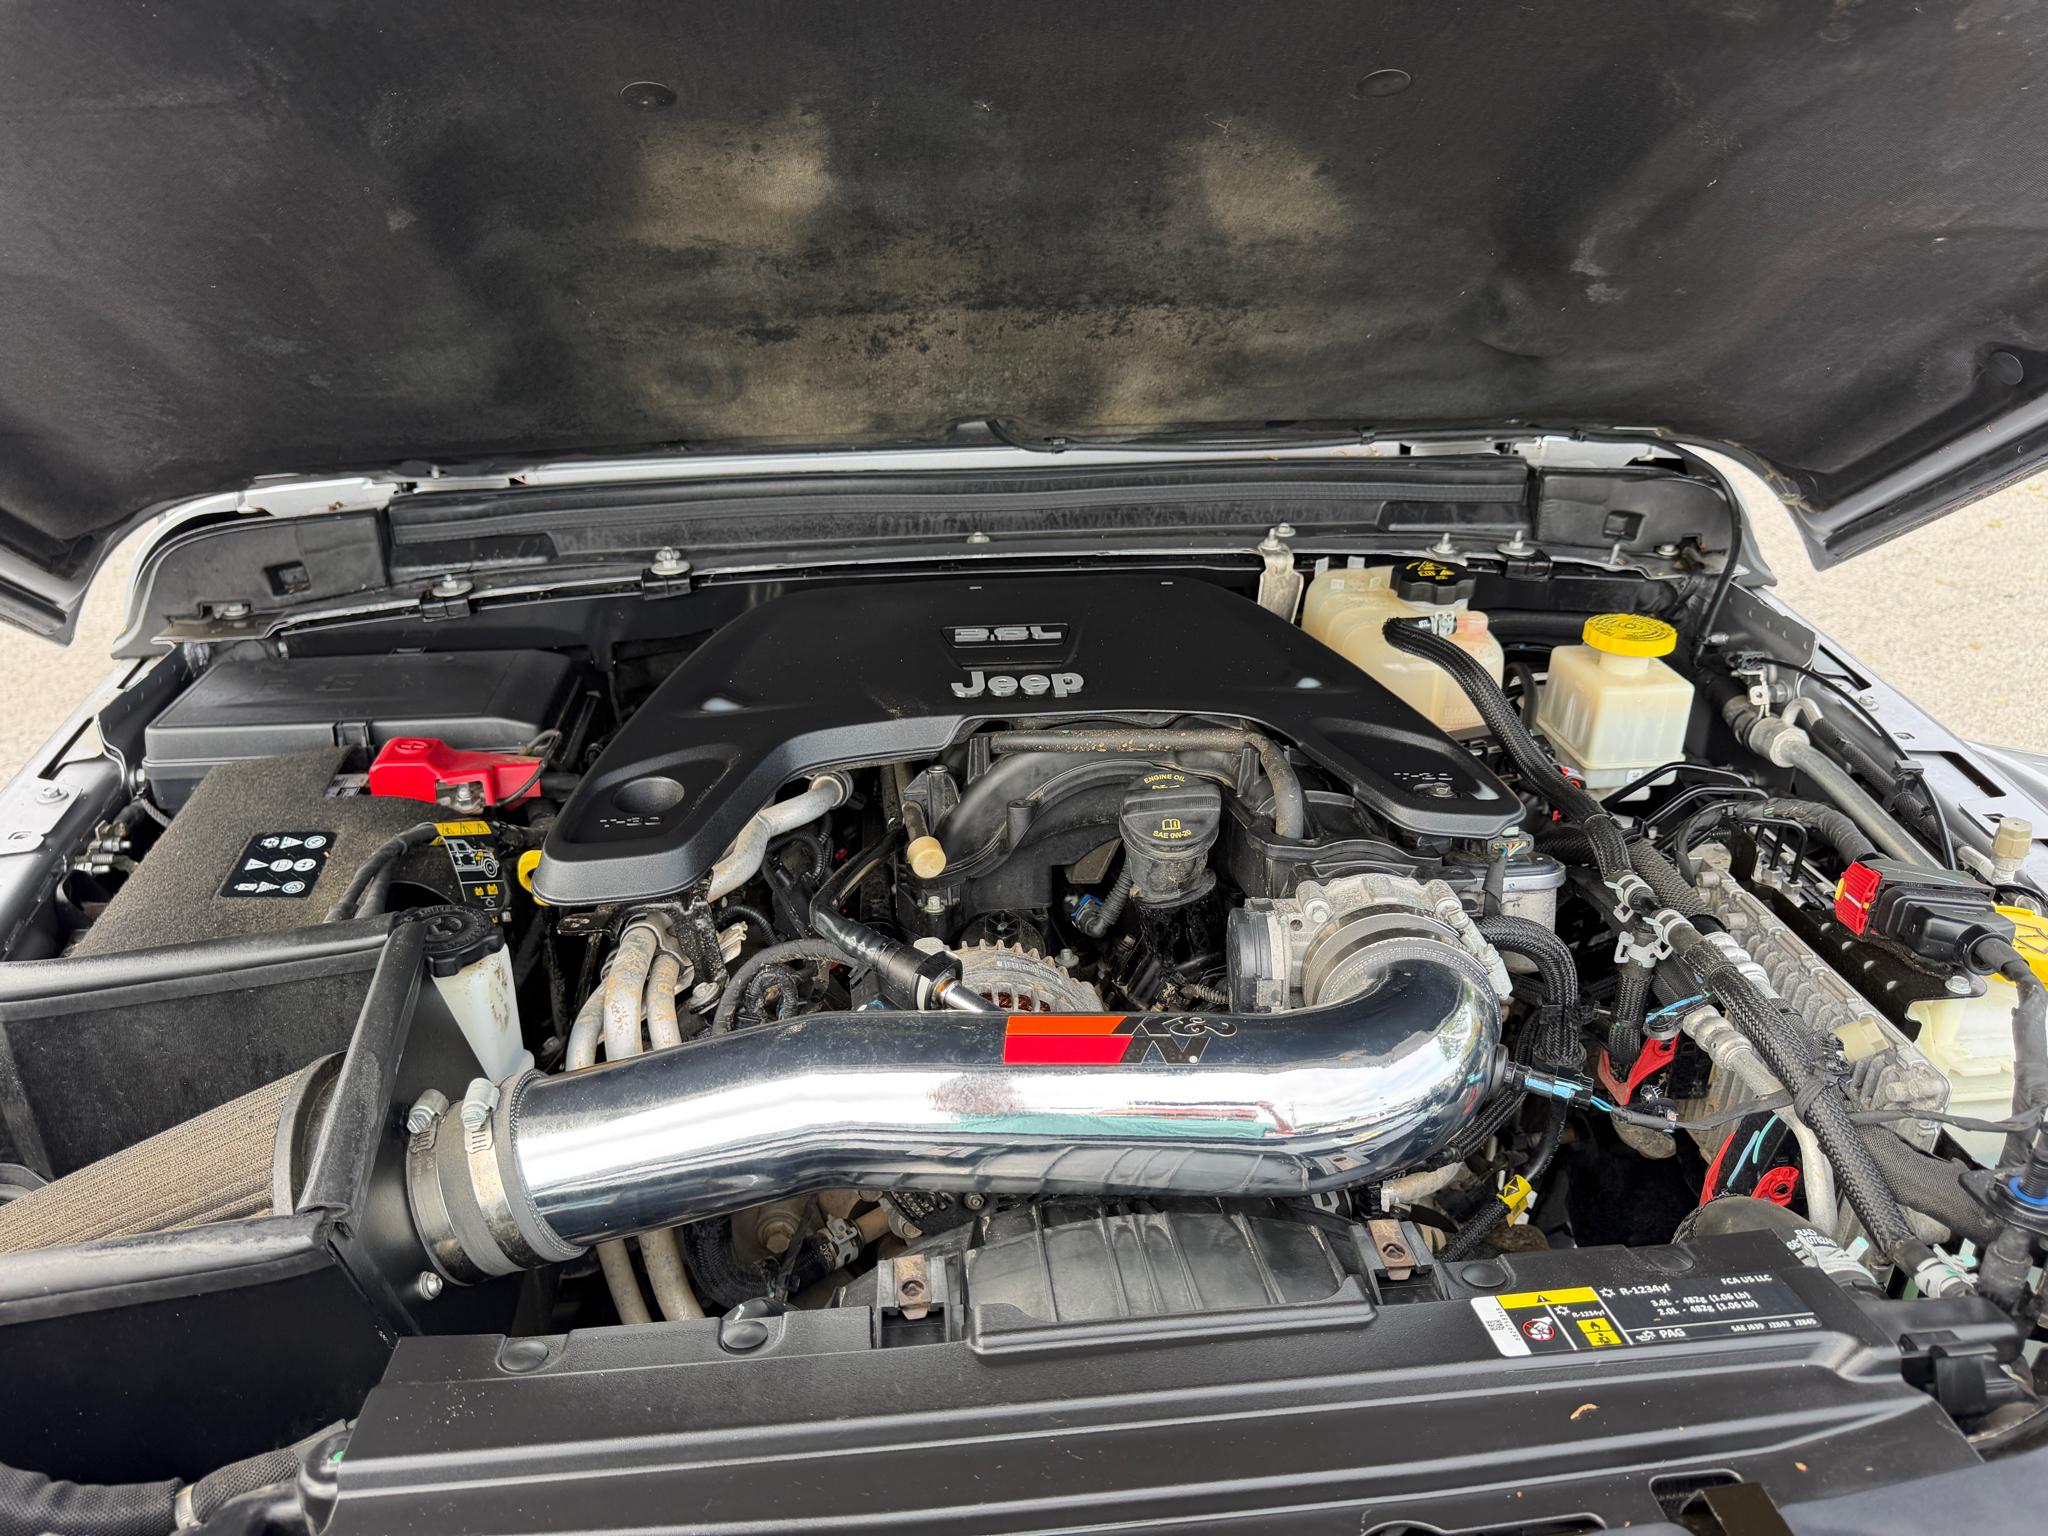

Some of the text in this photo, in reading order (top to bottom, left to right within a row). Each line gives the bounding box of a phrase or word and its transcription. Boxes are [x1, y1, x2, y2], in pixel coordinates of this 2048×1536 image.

[954, 626, 1062, 642] 3.6L
[951, 671, 1085, 698] Jeep
[1143, 774, 1186, 784] ENGINE OIL
[1152, 829, 1192, 839] SAE 0W-20
[1112, 1016, 1238, 1065] K&N
[1720, 1274, 1773, 1285] FCA US LLC
[1619, 1283, 1671, 1296] R-1234yf
[1650, 1299, 1672, 1307] 3.6L
[1657, 1307, 1680, 1316] 2.0L
[1658, 1328, 1686, 1338] PAG
